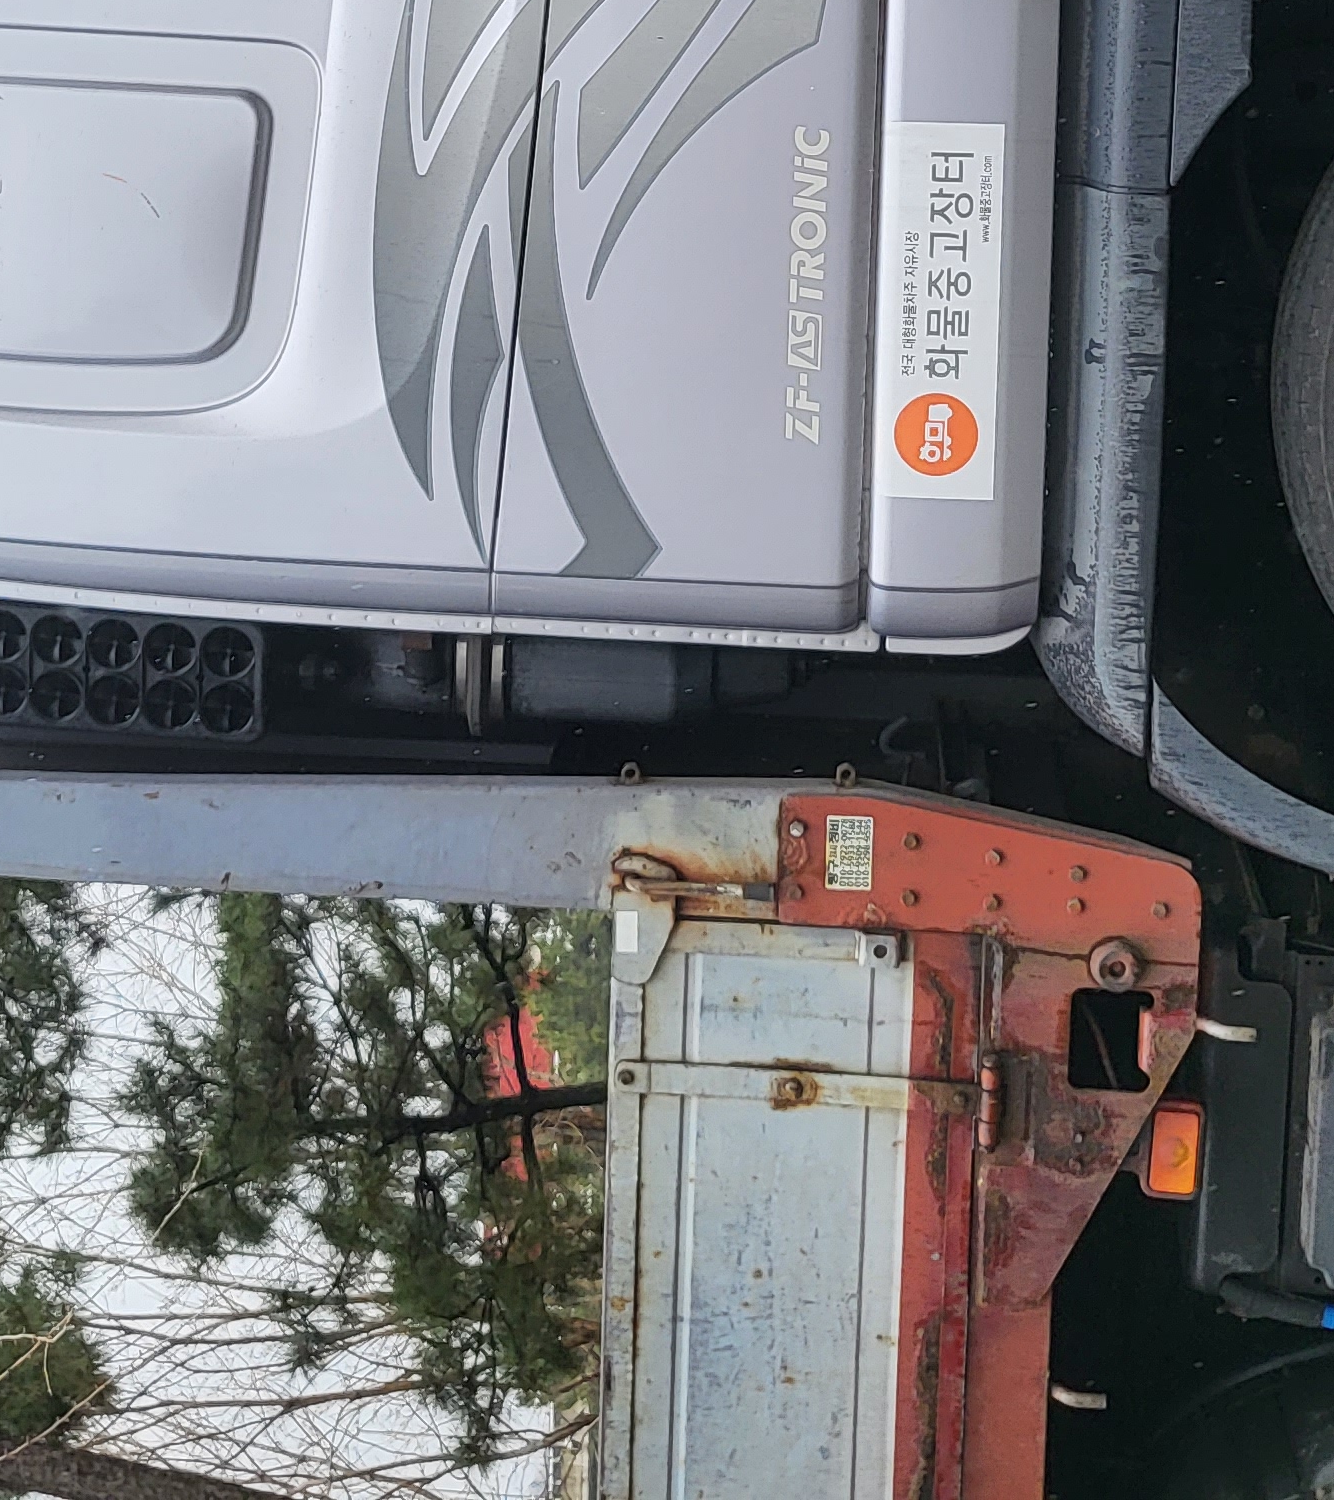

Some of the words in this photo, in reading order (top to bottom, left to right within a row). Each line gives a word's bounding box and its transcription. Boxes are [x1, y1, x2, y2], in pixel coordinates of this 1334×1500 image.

[979, 154, 993, 242] www.화물중고장터.com
[903, 229, 919, 276] 자유시장
[923, 150, 975, 380] 화물중고장터
[902, 280, 917, 348] 대형화물차주
[901, 352, 915, 376] 전국
